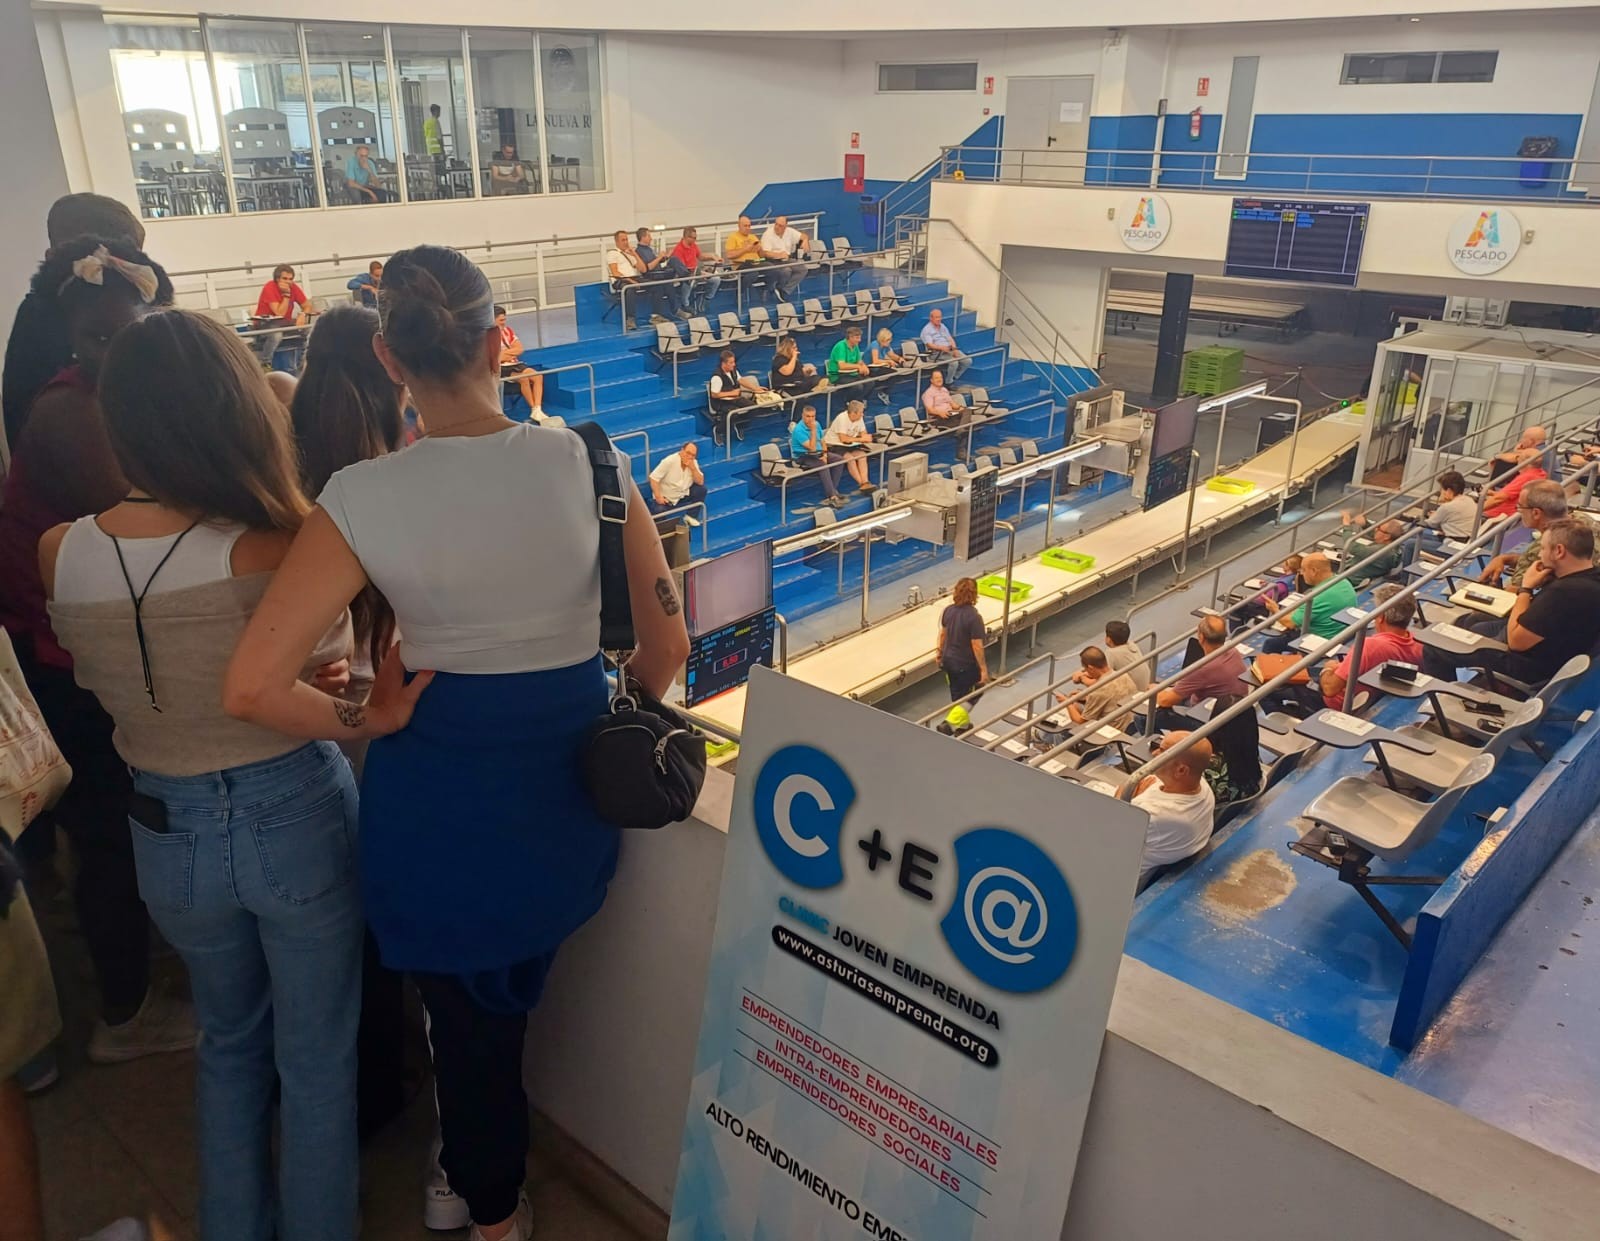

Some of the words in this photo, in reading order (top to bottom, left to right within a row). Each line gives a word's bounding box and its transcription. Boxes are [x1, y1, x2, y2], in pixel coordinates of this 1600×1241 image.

[545, 114, 579, 128] NUEVA
[1124, 229, 1162, 240] PESCADO
[1454, 249, 1508, 262] PESCADO
[778, 930, 989, 1062] www.asturiasemprenda.org
[832, 925, 889, 968] JOVEN
[892, 957, 1000, 1030] EMPRENDA
[741, 995, 860, 1080] EMPRENDEDORES
[865, 1073, 998, 1166] EMPRESARIALES
[756, 1048, 877, 1138] EMPRENDEDORES
[882, 1132, 961, 1193] SOCIALES
[775, 1038, 952, 1162] INTRA-EMPRENDEDORES
[435, 1190, 454, 1198] FILA
[705, 1102, 744, 1138] ALTO
[746, 1127, 860, 1220] RENDIMIENTO
[862, 1210, 907, 1241] EMP
